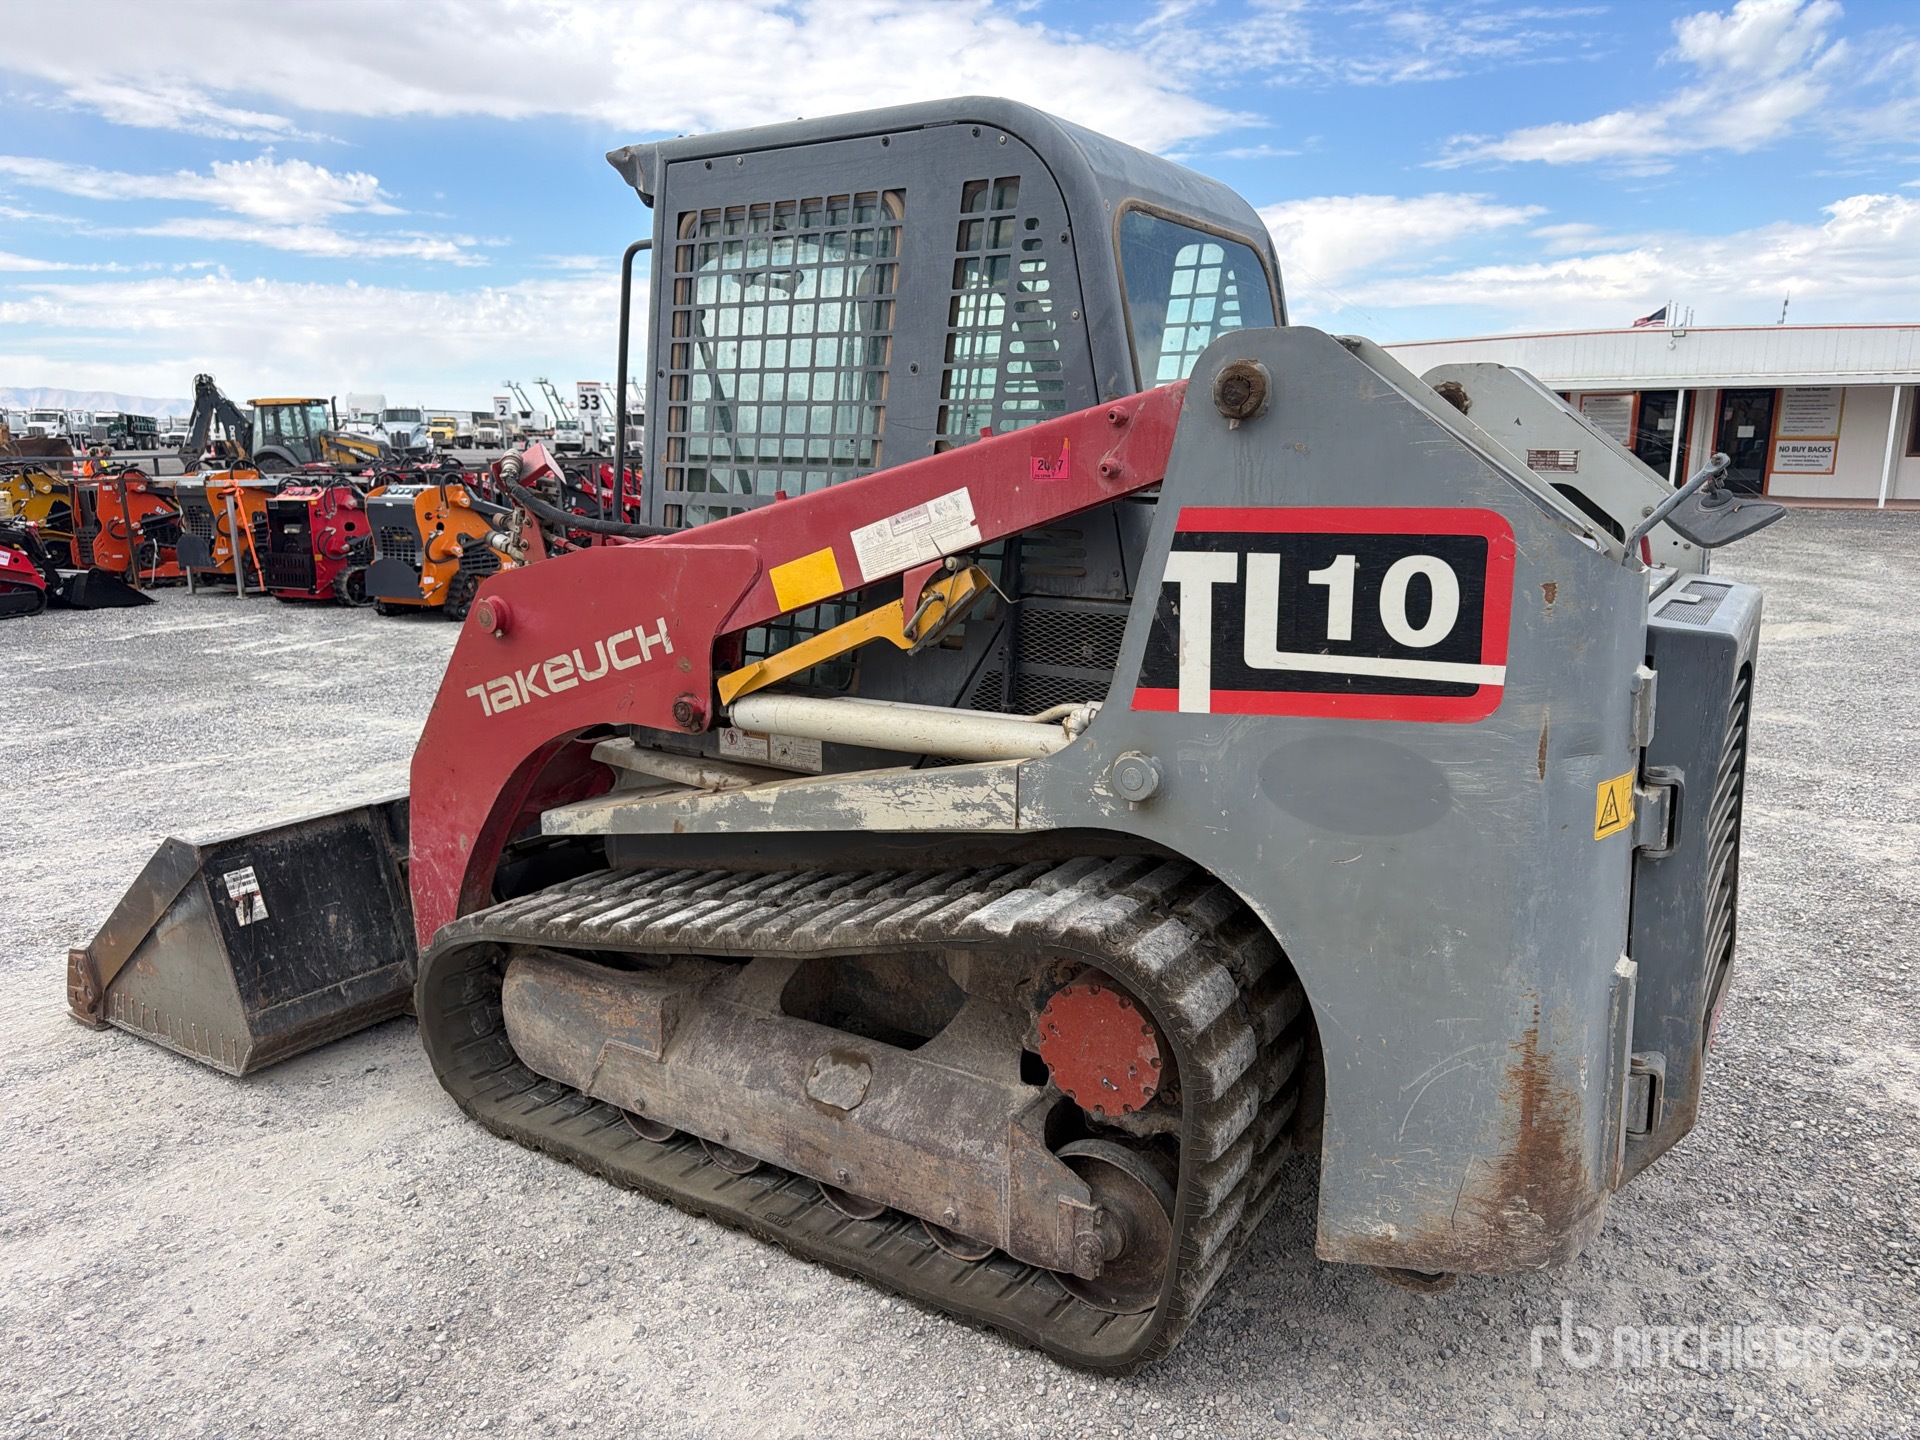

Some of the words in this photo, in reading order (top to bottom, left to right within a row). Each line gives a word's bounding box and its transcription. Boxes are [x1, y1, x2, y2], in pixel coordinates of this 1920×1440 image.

[580, 394, 600, 410] 33
[499, 404, 507, 416] 2
[77, 414, 83, 422] 6
[1037, 459, 1064, 473] 207
[1162, 551, 1506, 713] TL10
